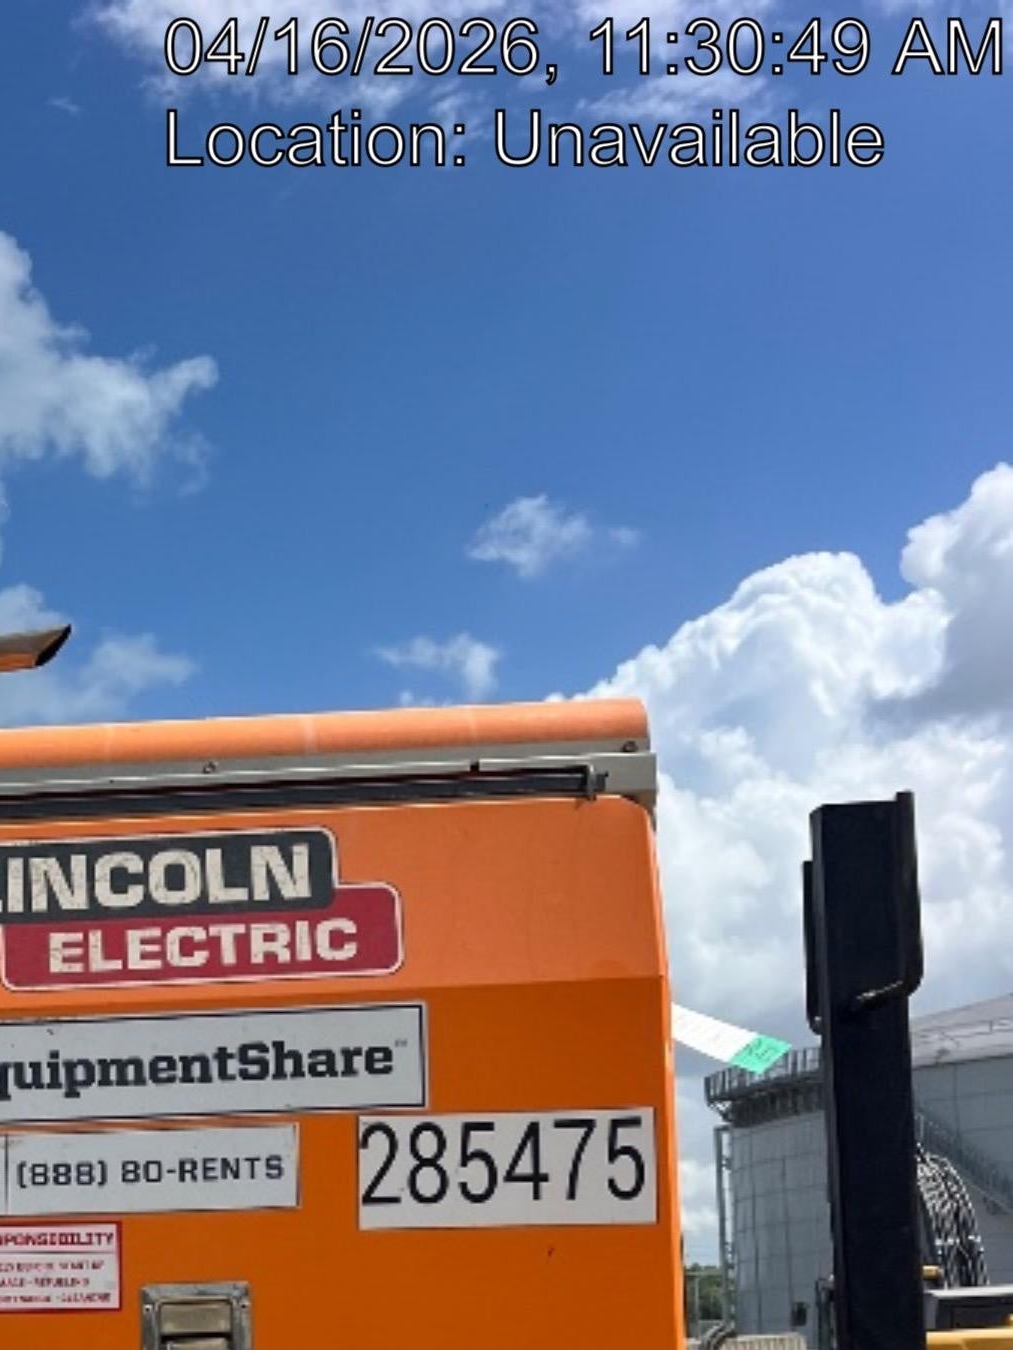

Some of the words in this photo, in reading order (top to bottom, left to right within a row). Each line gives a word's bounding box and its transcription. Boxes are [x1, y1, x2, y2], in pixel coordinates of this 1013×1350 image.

[48, 917, 358, 974] ELECTRIC
[16, 1158, 108, 1187] (888)
[120, 1154, 285, 1184] 80-RENTS
[359, 1115, 646, 1205] 285475
